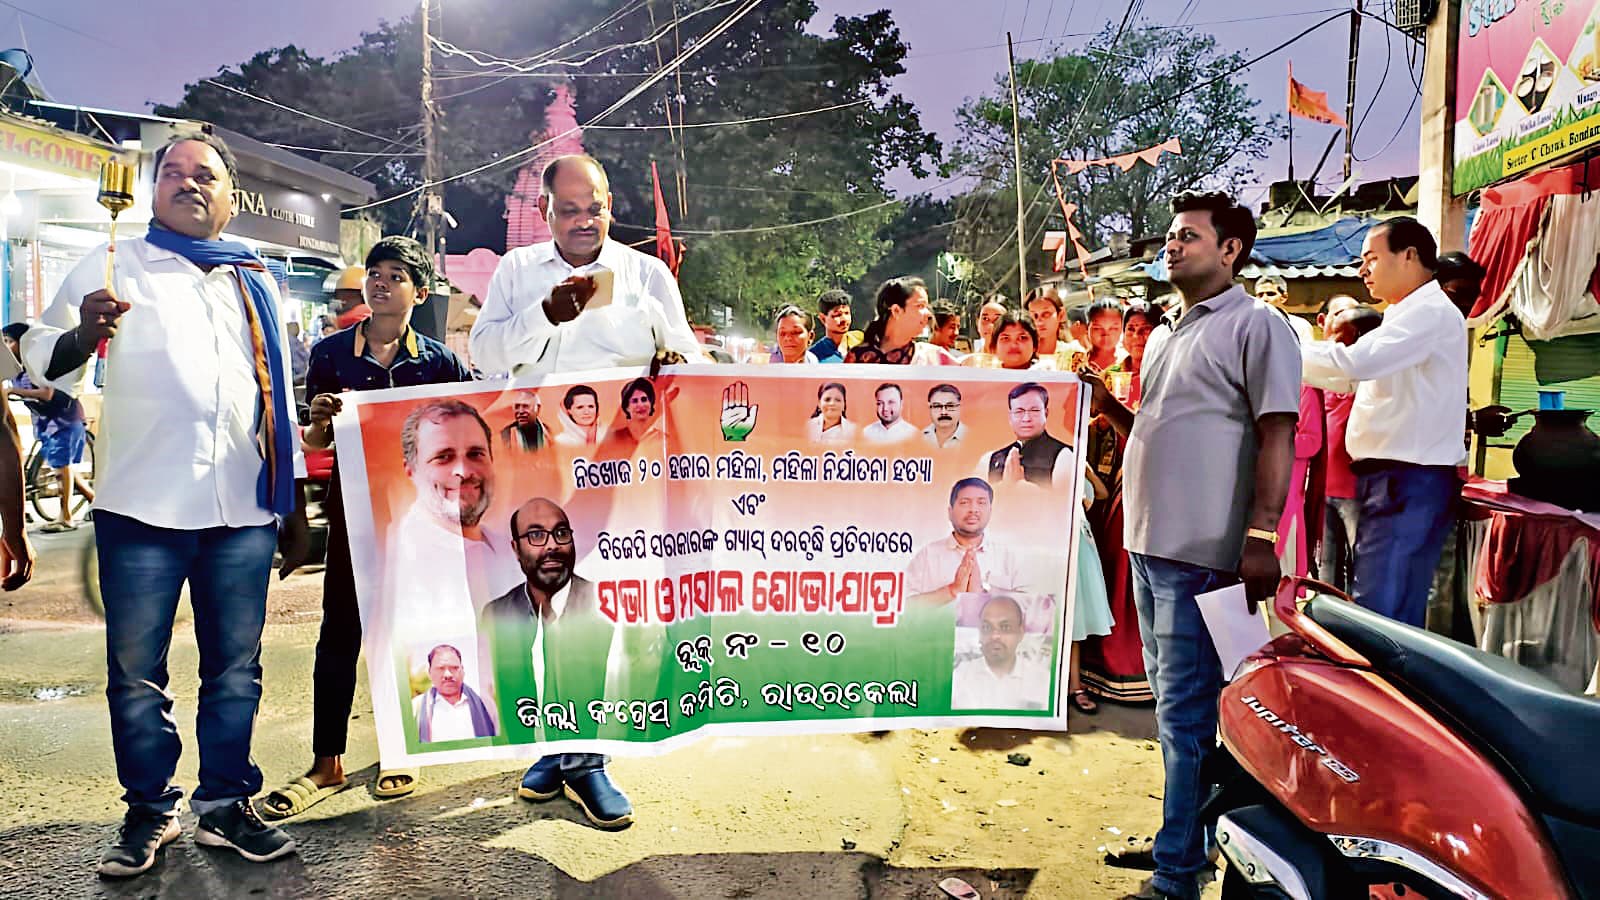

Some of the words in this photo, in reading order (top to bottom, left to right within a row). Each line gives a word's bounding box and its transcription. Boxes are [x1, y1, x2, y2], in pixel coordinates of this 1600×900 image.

[0, 130, 101, 172] LCOME
[271, 208, 294, 224] CLOTH
[296, 213, 315, 228] STORE
[574, 459, 631, 488] ନିଖୋଜ
[669, 455, 710, 479] ହଜାର
[716, 451, 767, 482] ମହିଳା,
[773, 452, 817, 481] ମହିଳା
[893, 459, 931, 482] ହତ୍ୟା
[732, 493, 766, 515] ଏବଂ
[598, 530, 646, 560] ବିଜେପି
[650, 529, 718, 558] ସରକାରଙ୍କ
[830, 526, 913, 558] ପ୍ରତିବାଦରେ
[598, 580, 648, 623] ସଭା
[654, 577, 675, 622] ଓ
[726, 633, 758, 657] ନଂ
[802, 633, 845, 654] ୧୦
[516, 698, 579, 733] ଜିଲ୍ଲା
[679, 677, 748, 717] କମିଟି,
[760, 680, 918, 711] ରାଉରକେଲା
